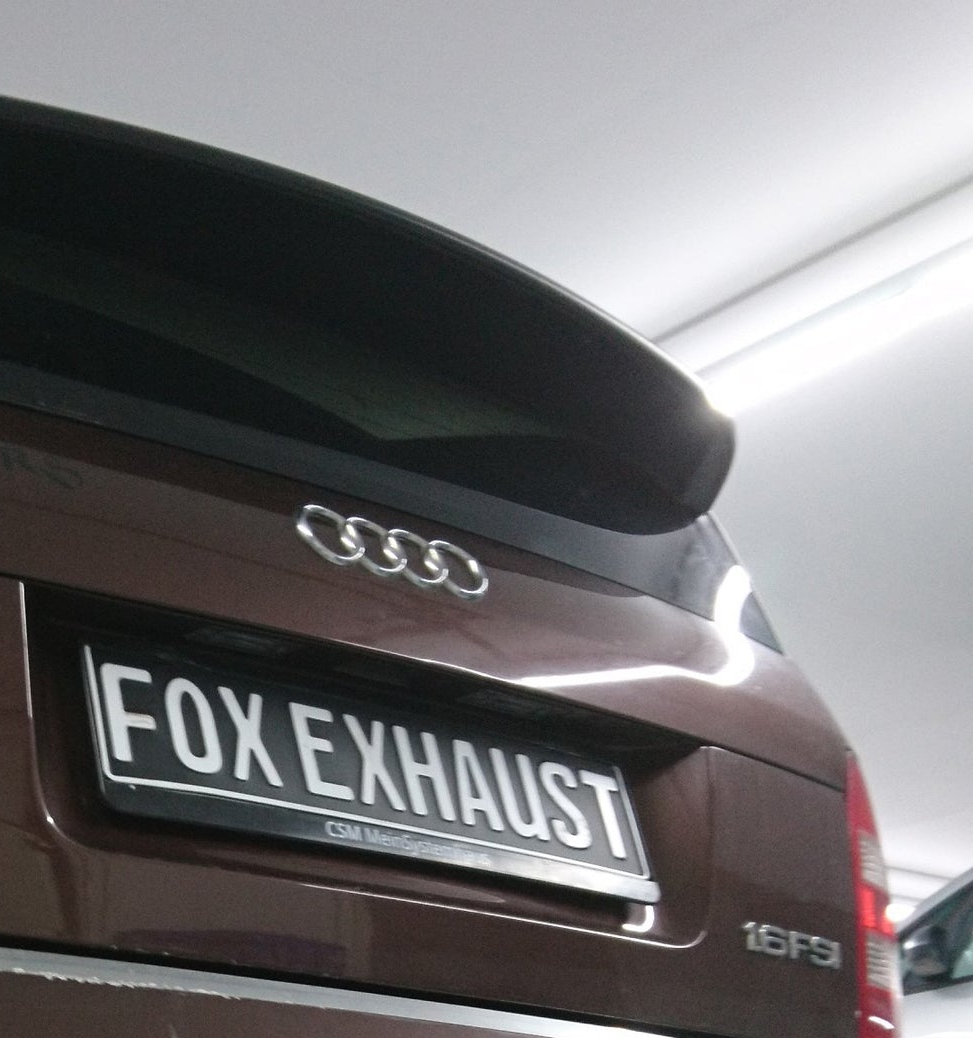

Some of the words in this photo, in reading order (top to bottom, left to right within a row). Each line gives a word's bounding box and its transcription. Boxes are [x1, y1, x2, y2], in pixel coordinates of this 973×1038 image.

[100, 661, 283, 788] FOX
[289, 701, 627, 861] EXHAUST
[325, 820, 363, 842] CSM
